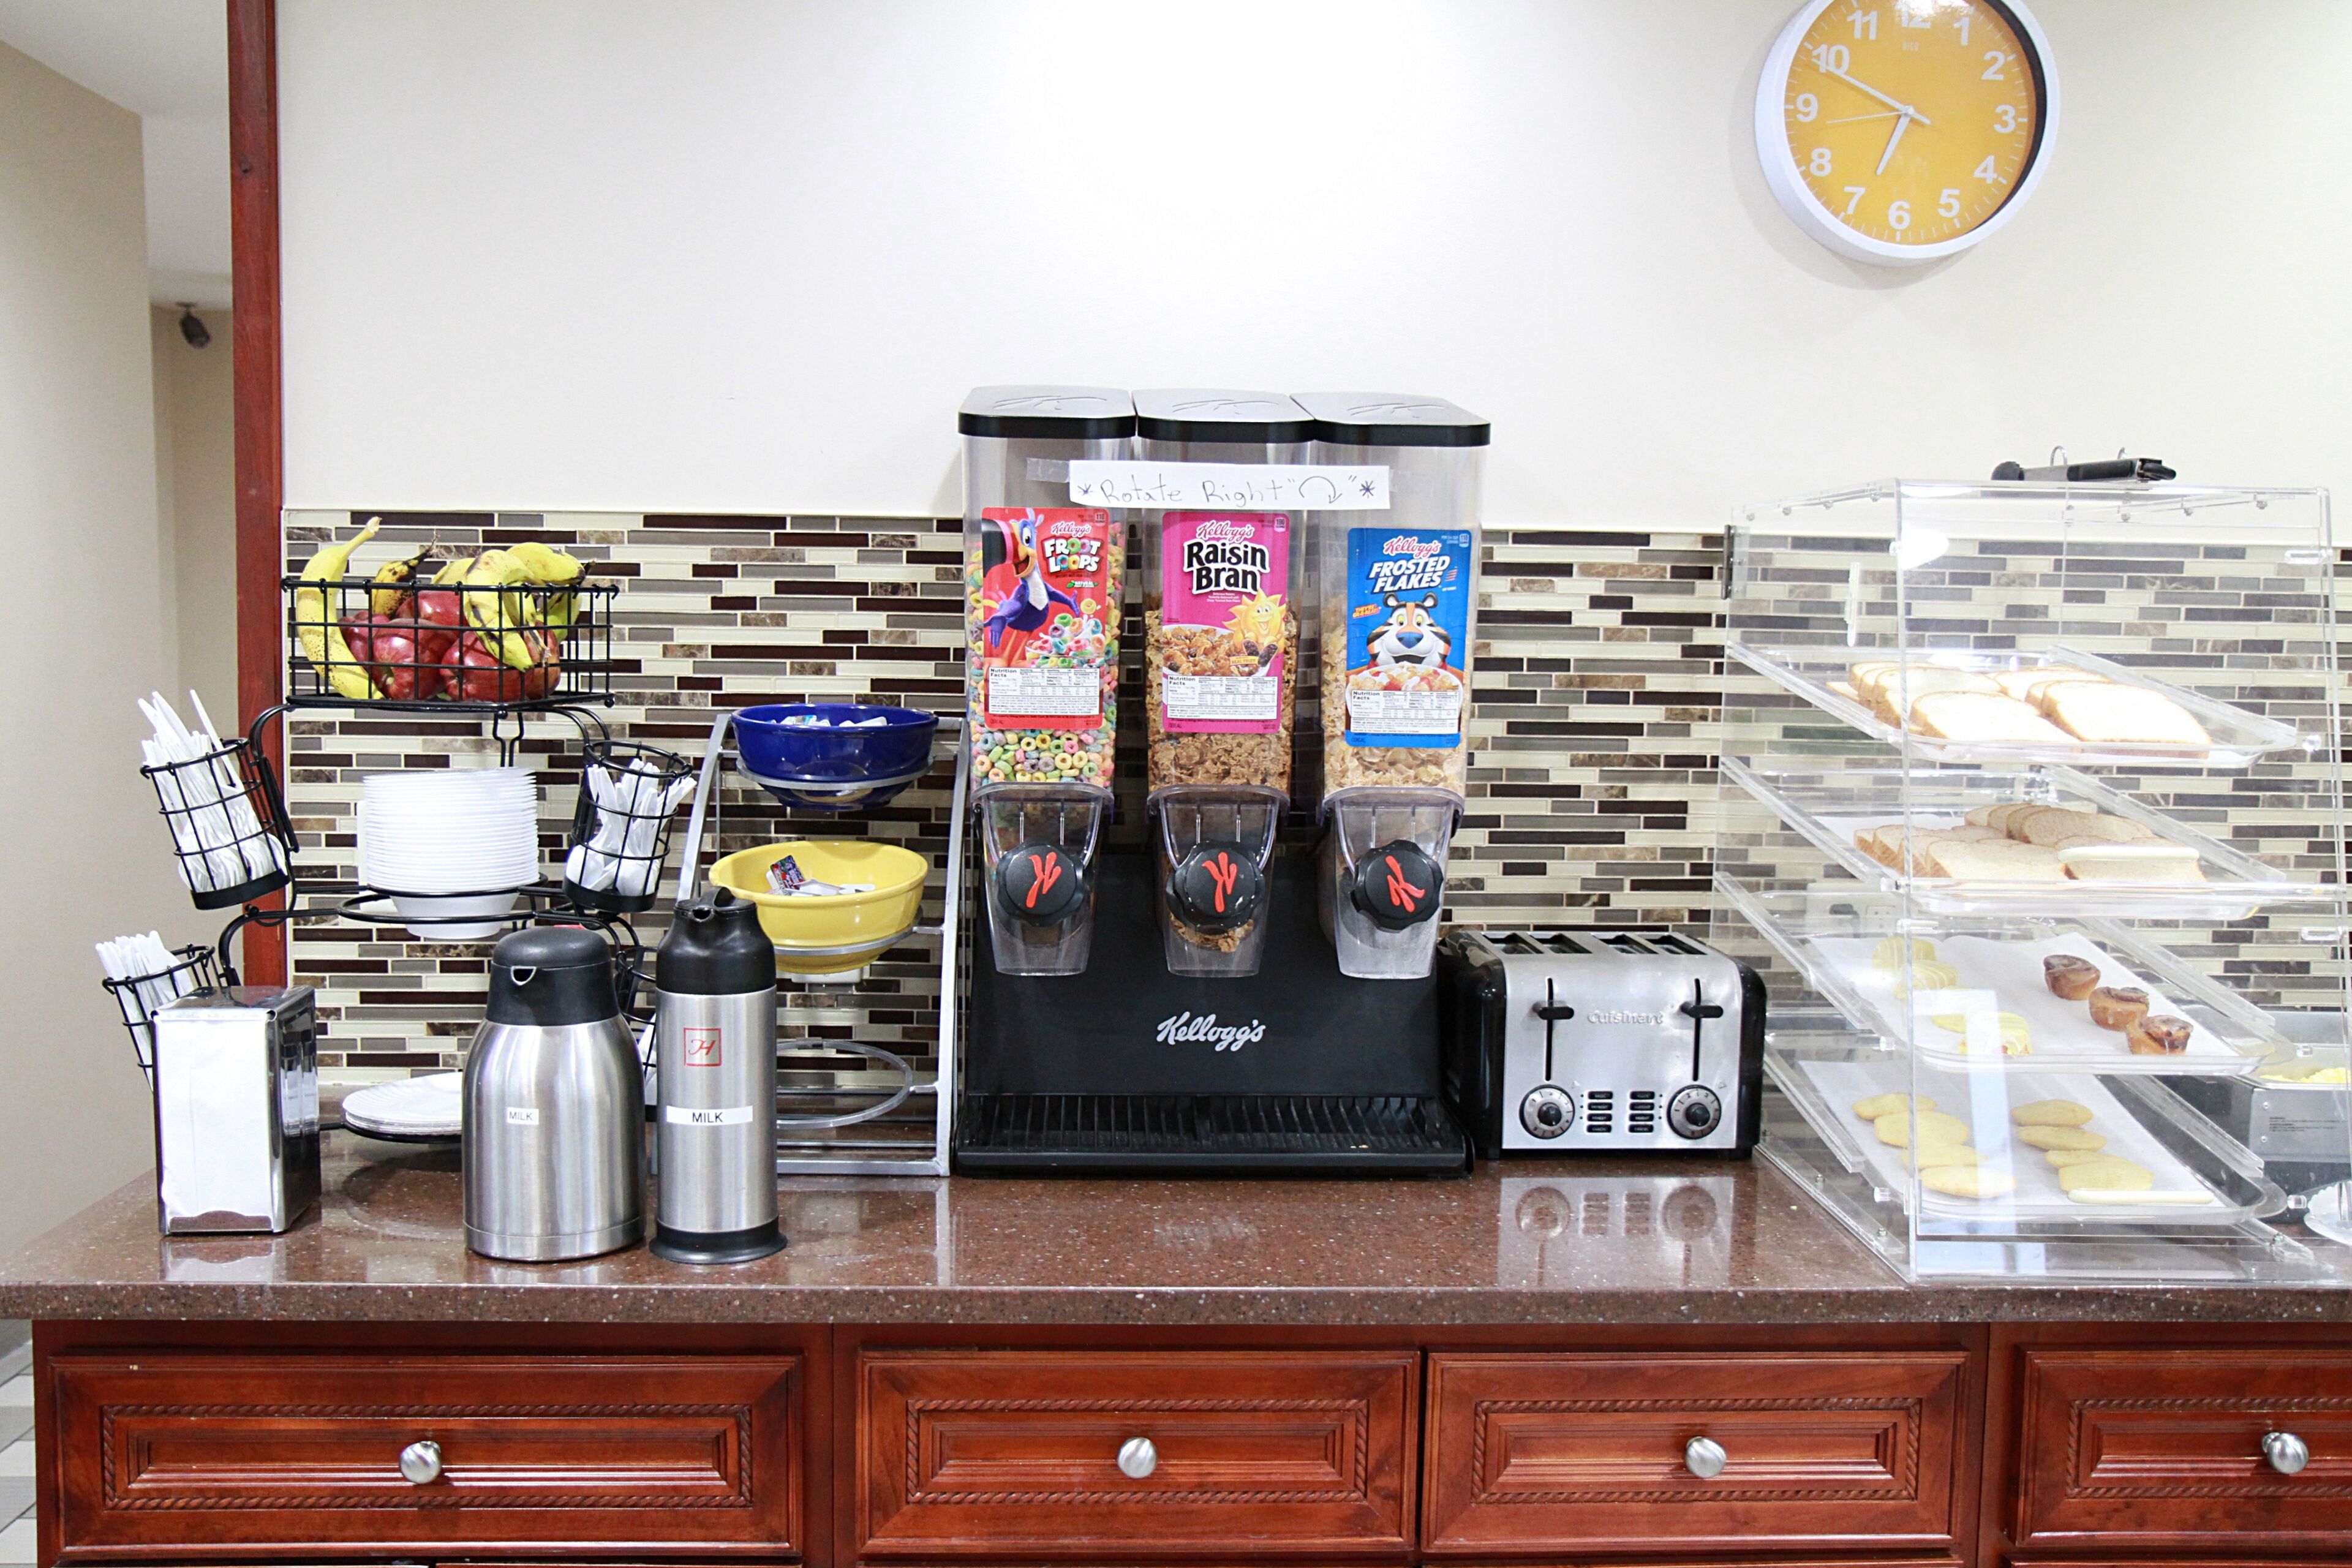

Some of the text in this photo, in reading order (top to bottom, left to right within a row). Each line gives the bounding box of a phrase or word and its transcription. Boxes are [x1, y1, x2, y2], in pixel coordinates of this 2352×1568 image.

[1847, 10, 1879, 40] 11
[1953, 17, 1970, 45] 1
[1812, 45, 1850, 73] 10
[1981, 51, 2005, 80] 2
[1796, 94, 1819, 122] 9
[1994, 105, 2016, 133] 3
[1810, 149, 1831, 176] 8
[1973, 156, 1997, 183] 4
[1843, 187, 1866, 214] 7
[1938, 189, 1960, 217] 5
[1888, 202, 1910, 230] 6
[1100, 473, 1182, 503] Rotate
[1051, 522, 1091, 537] Kellogg's
[1197, 521, 1254, 542] Kellogg's
[1044, 538, 1101, 557] FROOT
[1187, 541, 1267, 570] Raisin
[1384, 537, 1440, 558] Kellogg's
[1049, 554, 1099, 573] LOOPS
[1369, 556, 1450, 578] FROSTED
[1196, 567, 1258, 592] Bran
[1373, 571, 1443, 593] FLAKES
[1587, 1010, 1664, 1024] Cuisinart
[1156, 1011, 1266, 1051] Kellogg's
[509, 1111, 533, 1121] MILK
[692, 1112, 723, 1123] MILK
